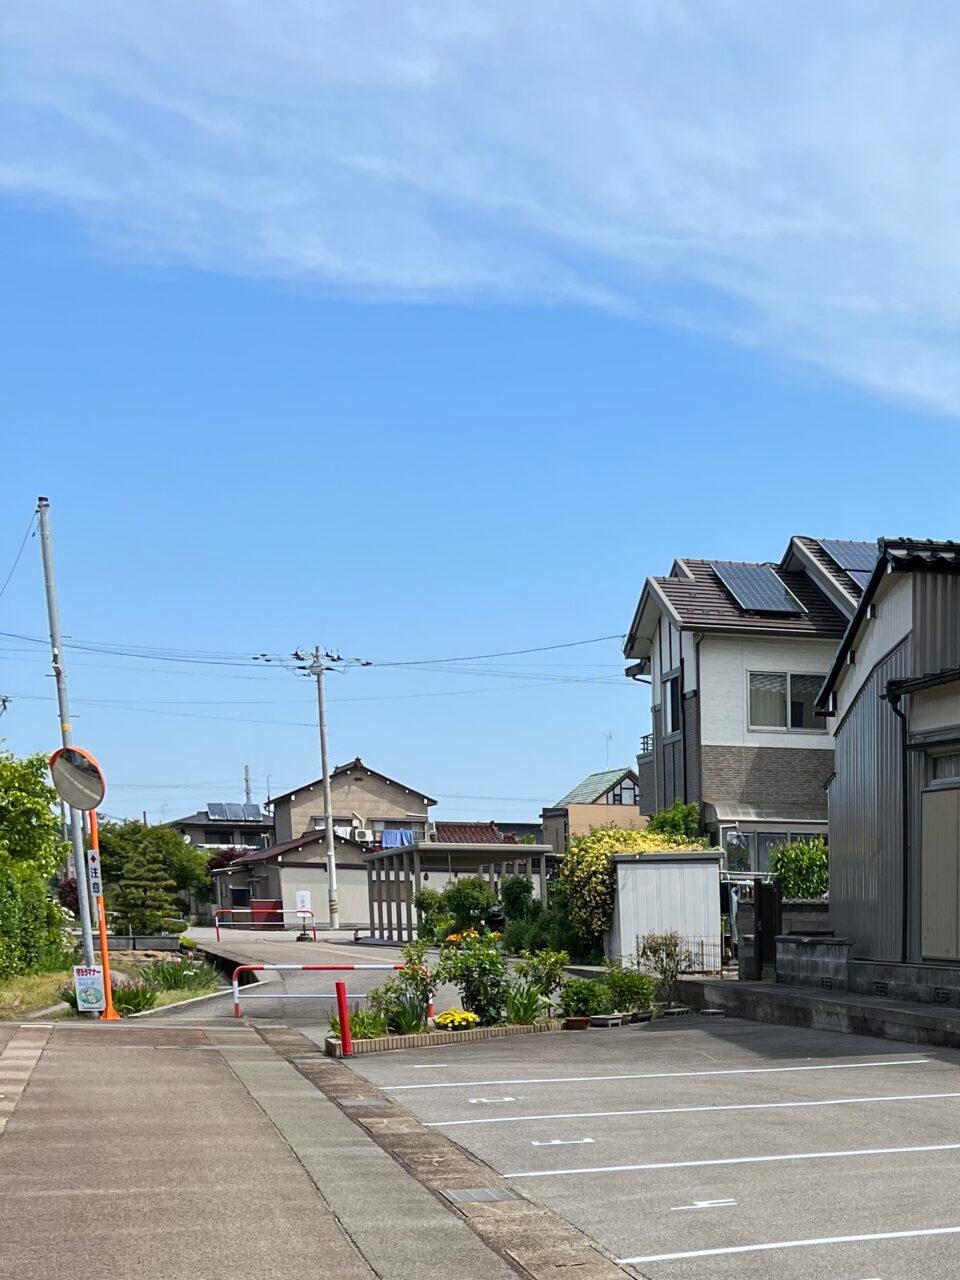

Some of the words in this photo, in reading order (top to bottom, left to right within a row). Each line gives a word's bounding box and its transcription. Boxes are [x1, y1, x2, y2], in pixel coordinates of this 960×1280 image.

[90, 867, 100, 893] 注意
[468, 1096, 516, 1104] 2
[531, 1138, 596, 1146] 3
[670, 1198, 737, 1211] 4
